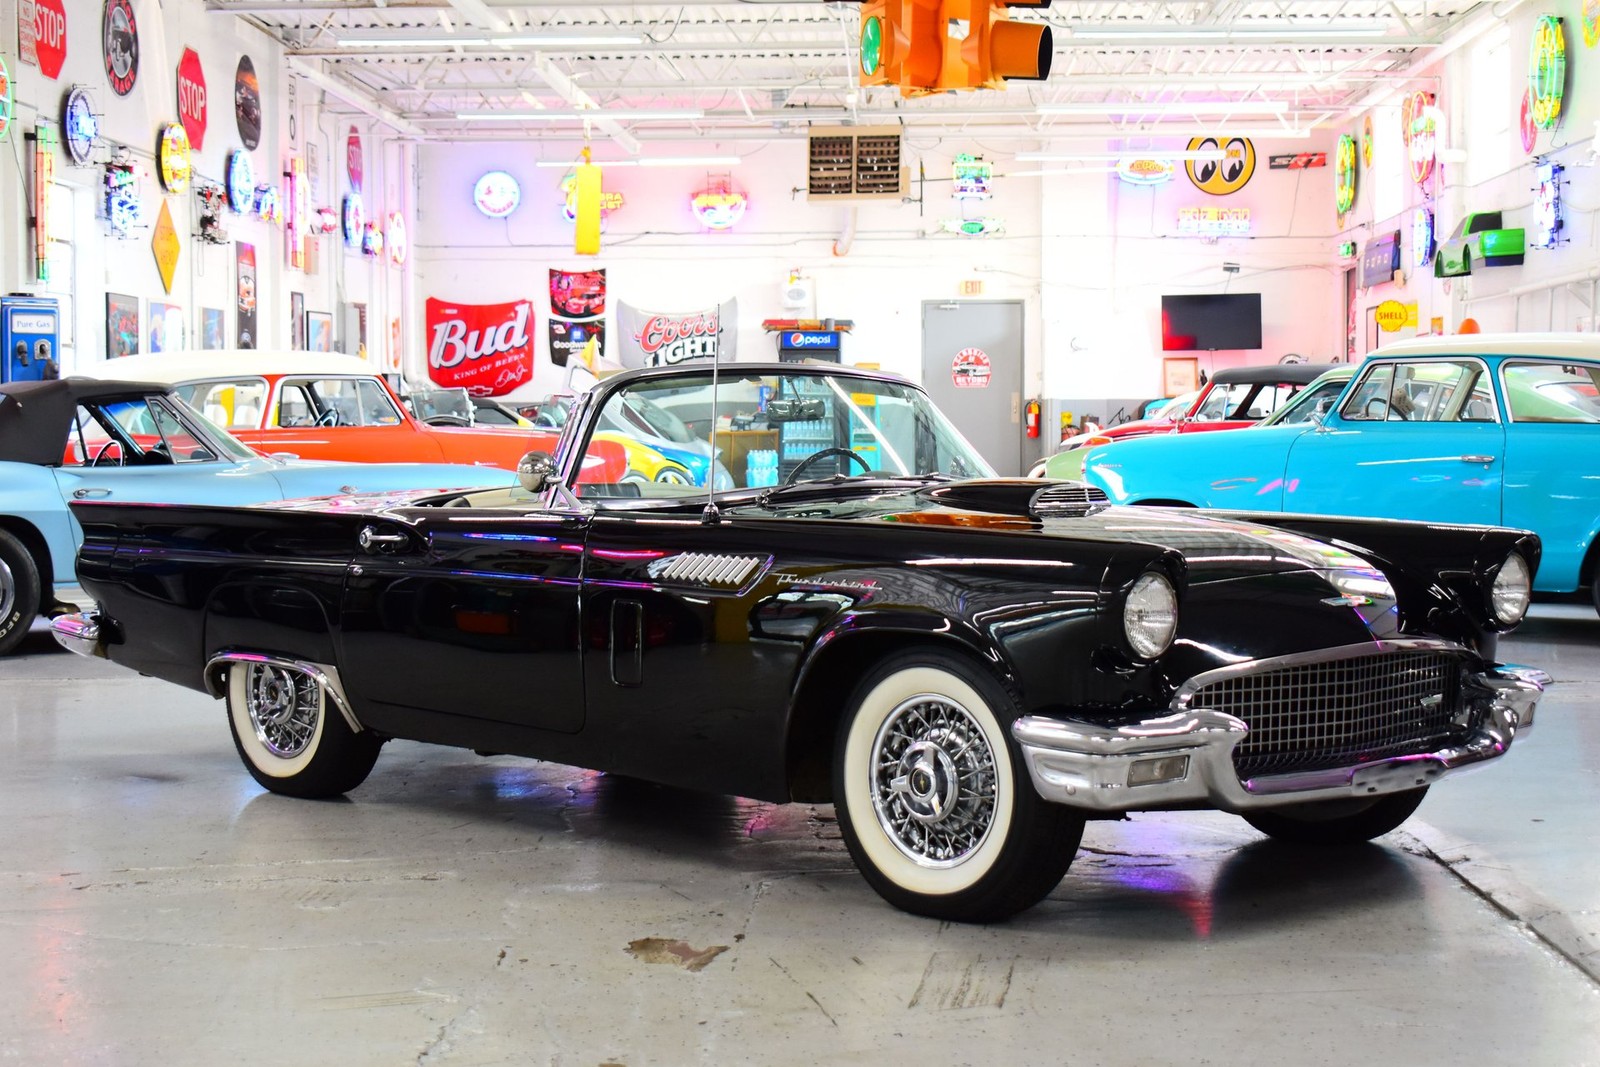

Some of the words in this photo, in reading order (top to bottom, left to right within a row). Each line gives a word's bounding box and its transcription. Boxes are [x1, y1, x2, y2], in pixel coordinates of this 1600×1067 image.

[35, 3, 65, 50] STOP
[179, 76, 206, 121] STOP
[964, 281, 982, 294] EXIT
[16, 320, 33, 328] Pure
[36, 320, 50, 328] Gas
[1378, 312, 1403, 320] SHELL
[430, 303, 530, 369] Bud
[632, 312, 719, 353] Coors
[804, 335, 831, 345] pepsi
[644, 336, 717, 368] LIGHT
[453, 370, 478, 380] KING
[479, 364, 493, 373] OF
[494, 353, 526, 368] BEERS
[956, 376, 988, 384] BEYOND
[769, 573, 882, 590] Thunderbird
